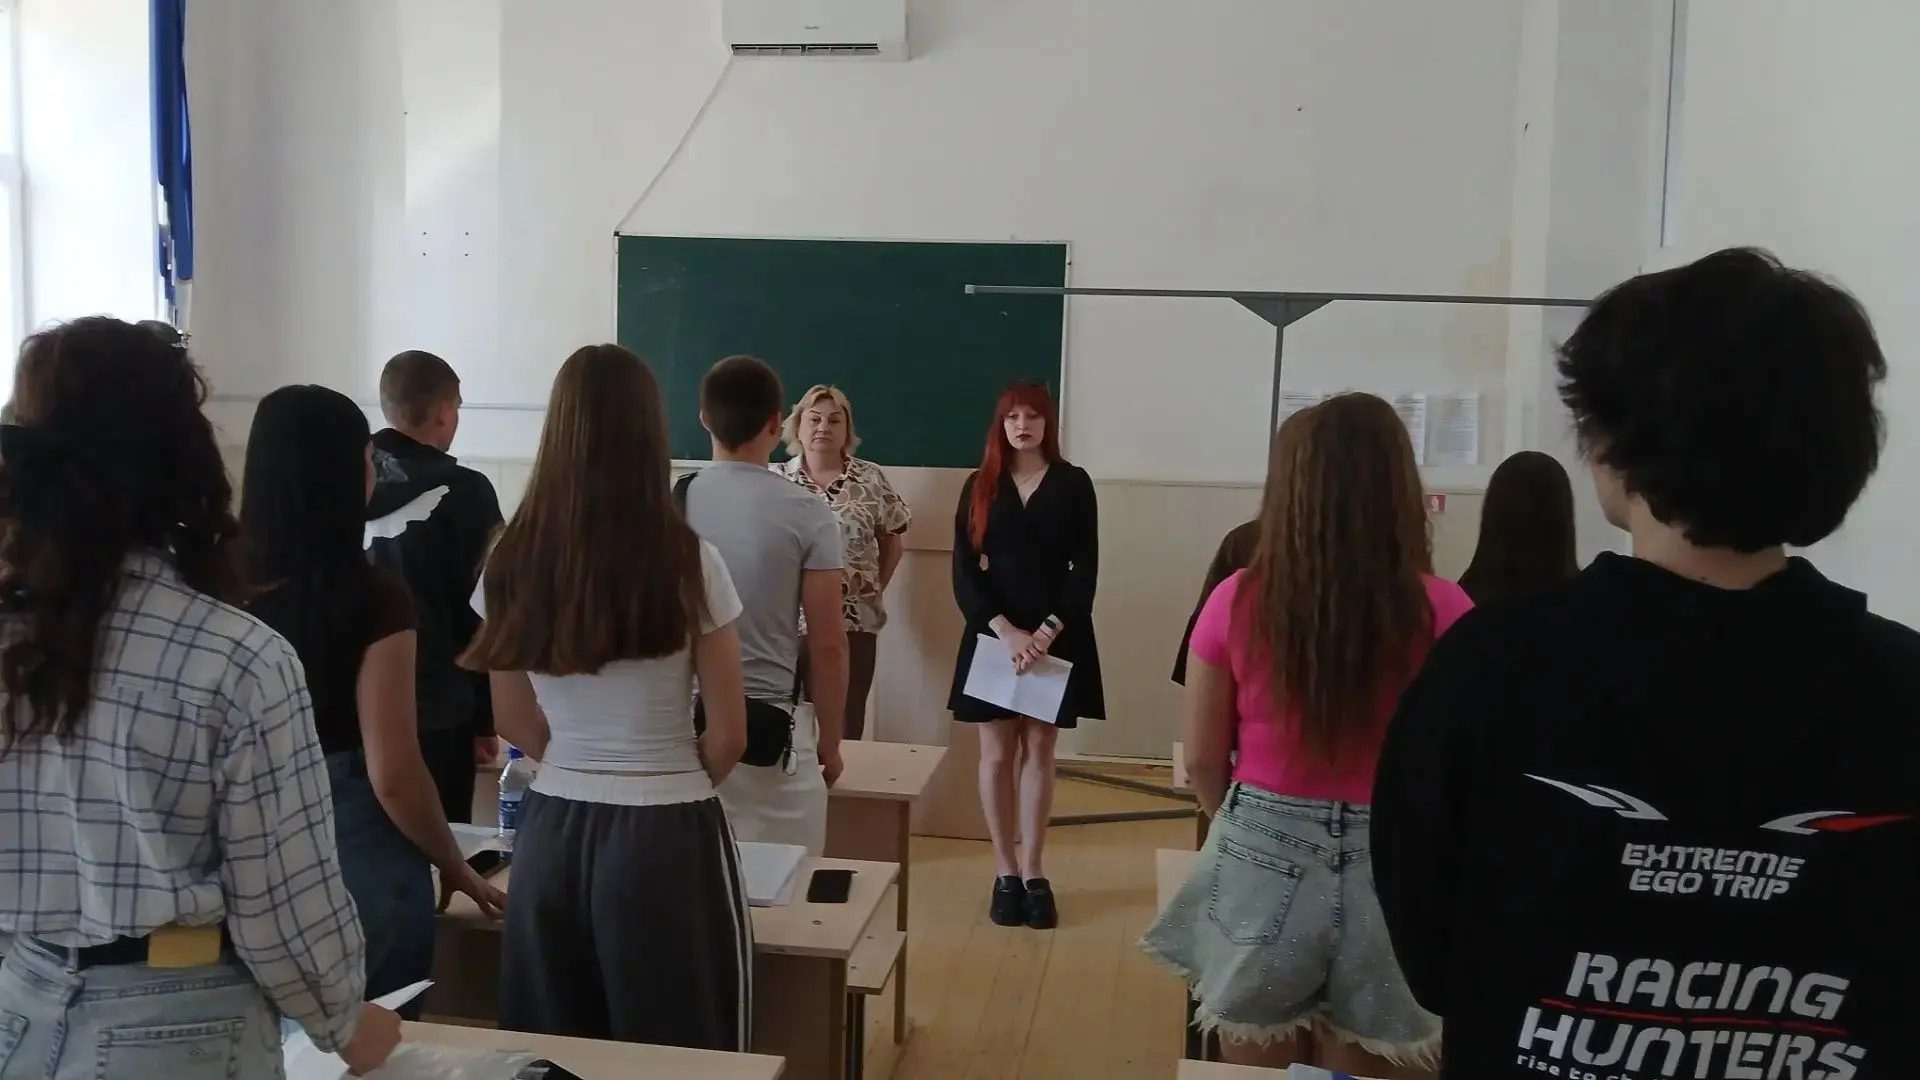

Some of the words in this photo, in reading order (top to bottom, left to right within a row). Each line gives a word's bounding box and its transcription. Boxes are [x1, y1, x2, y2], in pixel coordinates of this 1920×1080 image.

[1621, 842, 1806, 878] EXTREME
[1629, 868, 1704, 894] EGO
[1711, 872, 1791, 901] TRIP
[1565, 951, 1850, 1021] RACING
[1517, 1006, 1867, 1080] HUNTERS
[1516, 1054, 1561, 1077] rise
